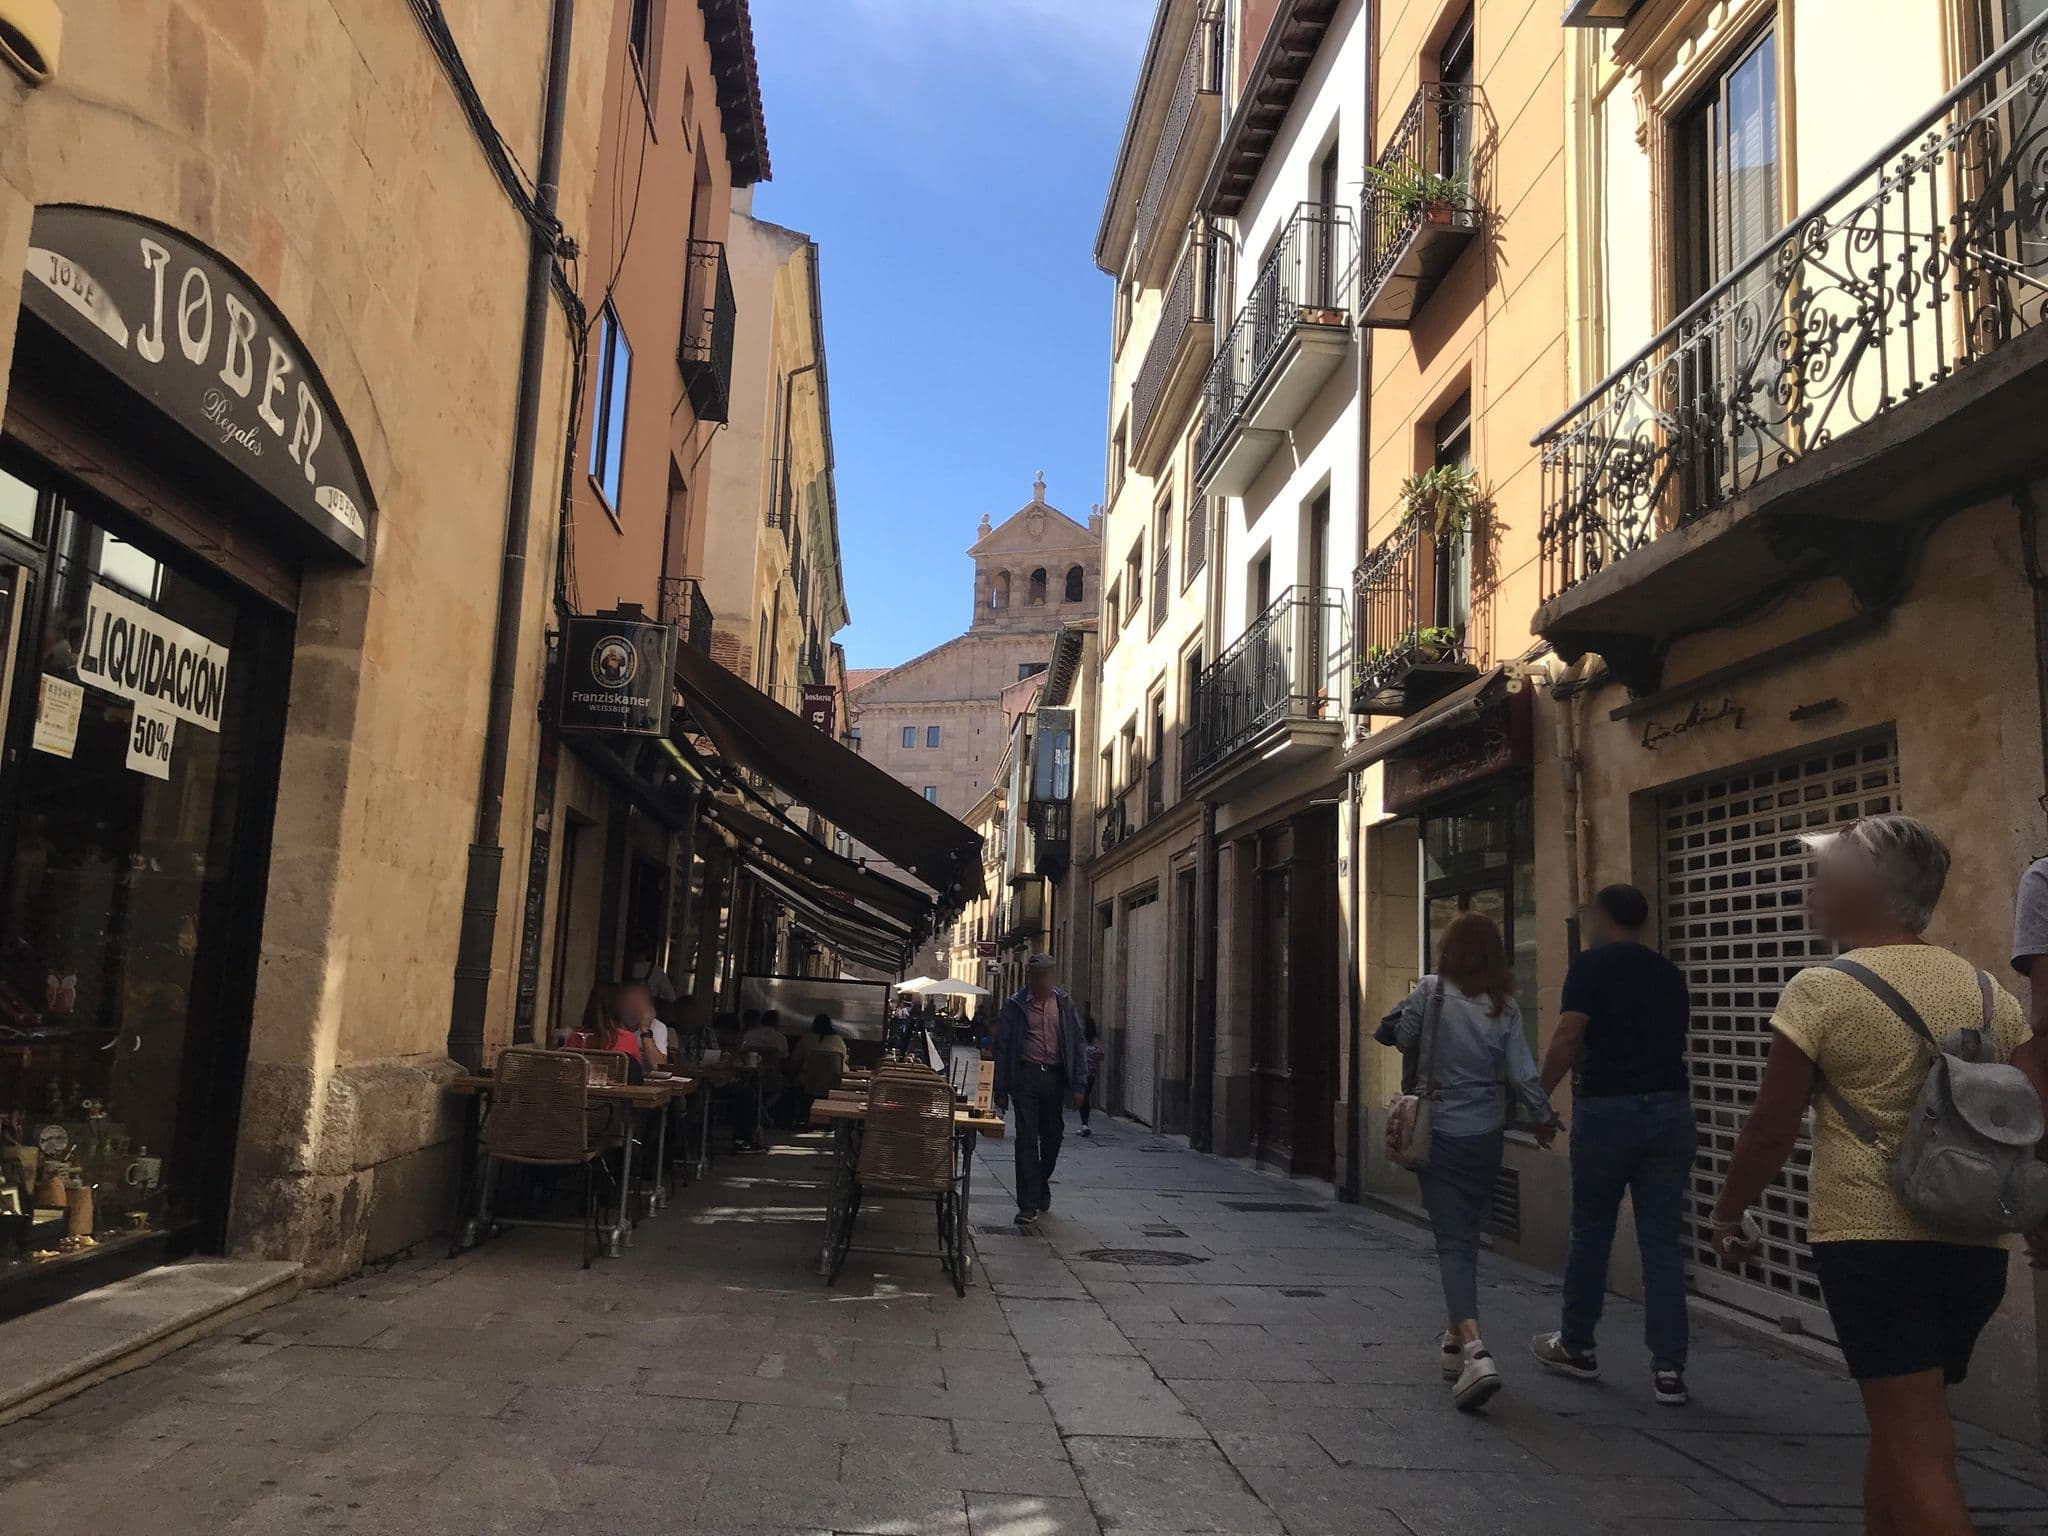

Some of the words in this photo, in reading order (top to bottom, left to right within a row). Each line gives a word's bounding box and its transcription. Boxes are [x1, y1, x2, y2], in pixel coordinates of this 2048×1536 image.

[137, 237, 323, 485] JOBEN
[201, 388, 264, 457] Regalos
[81, 605, 225, 722] LIQUIDACIÓN
[572, 691, 651, 707] Franziskaner
[589, 704, 631, 714] WEISSBIER
[133, 715, 169, 762] 50%
